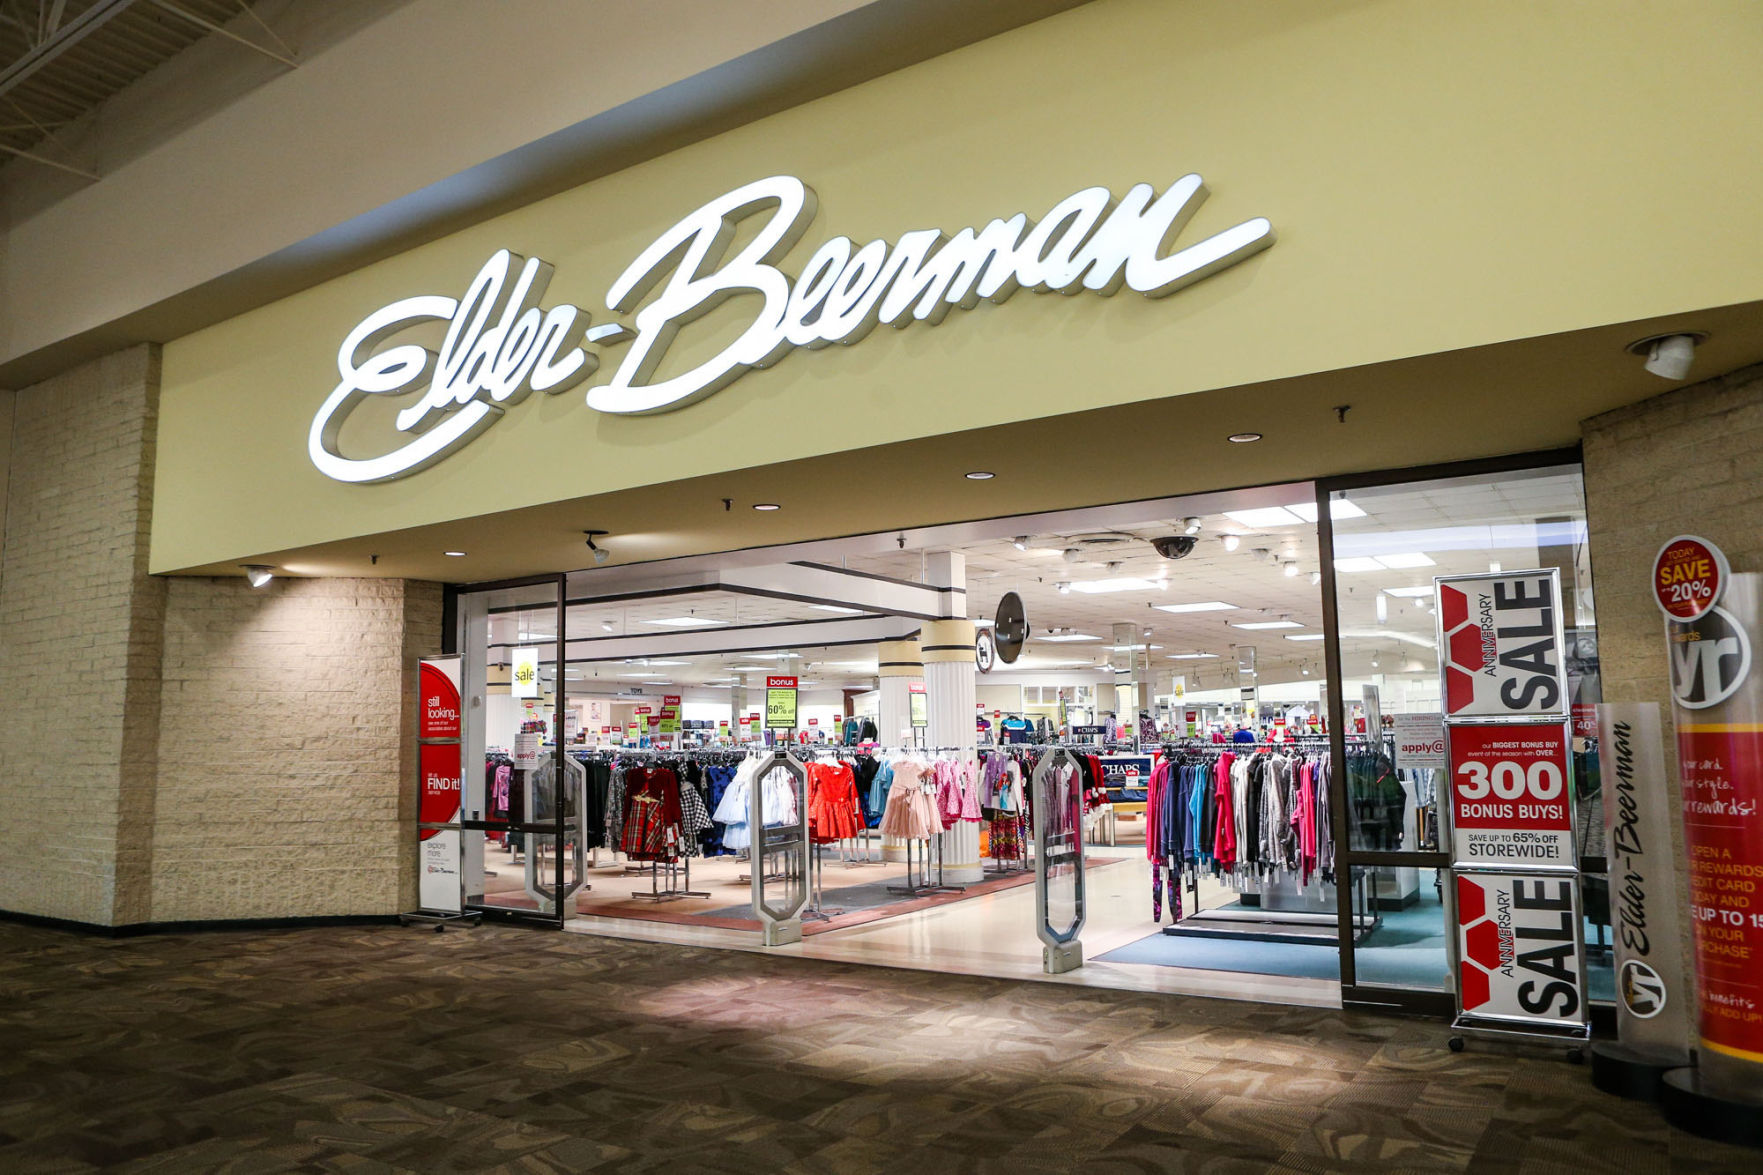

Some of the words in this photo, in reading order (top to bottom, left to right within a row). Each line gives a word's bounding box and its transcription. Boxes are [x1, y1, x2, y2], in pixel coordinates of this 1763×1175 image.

[308, 171, 1276, 484] Elder-Beerman
[1668, 547, 1695, 560] TODAY
[1660, 559, 1711, 585] SAVE
[1671, 579, 1711, 602] 20%
[1478, 593, 1497, 677] ANNIVERSARY
[1493, 579, 1559, 710] SALE
[514, 668, 536, 682] sale
[1672, 637, 1739, 702] yr
[769, 678, 794, 686] bonus
[427, 695, 440, 707] still
[768, 704, 787, 715] 60%
[1401, 739, 1445, 754] apply@
[1101, 763, 1140, 775] CHAPS
[427, 777, 451, 790] FIND
[1457, 761, 1562, 800] 300
[1461, 804, 1513, 818] BONUS
[1519, 804, 1563, 819] BUYS!
[1468, 834, 1487, 842] SAVE
[1489, 834, 1499, 842] UP
[1502, 834, 1511, 843] TO
[1512, 832, 1541, 843] 65%
[1542, 835, 1559, 843] OFF
[1613, 720, 1650, 956] Elder-Beerman
[1469, 843, 1559, 858] STOREWIDE!
[1716, 879, 1755, 893] CARD
[1720, 895, 1750, 908] AND
[1699, 905, 1717, 922] UP
[1719, 909, 1744, 926] TO
[1497, 889, 1514, 978] ANNIVERSARY
[1708, 926, 1744, 942] YOUR
[1512, 879, 1579, 1017] SALE
